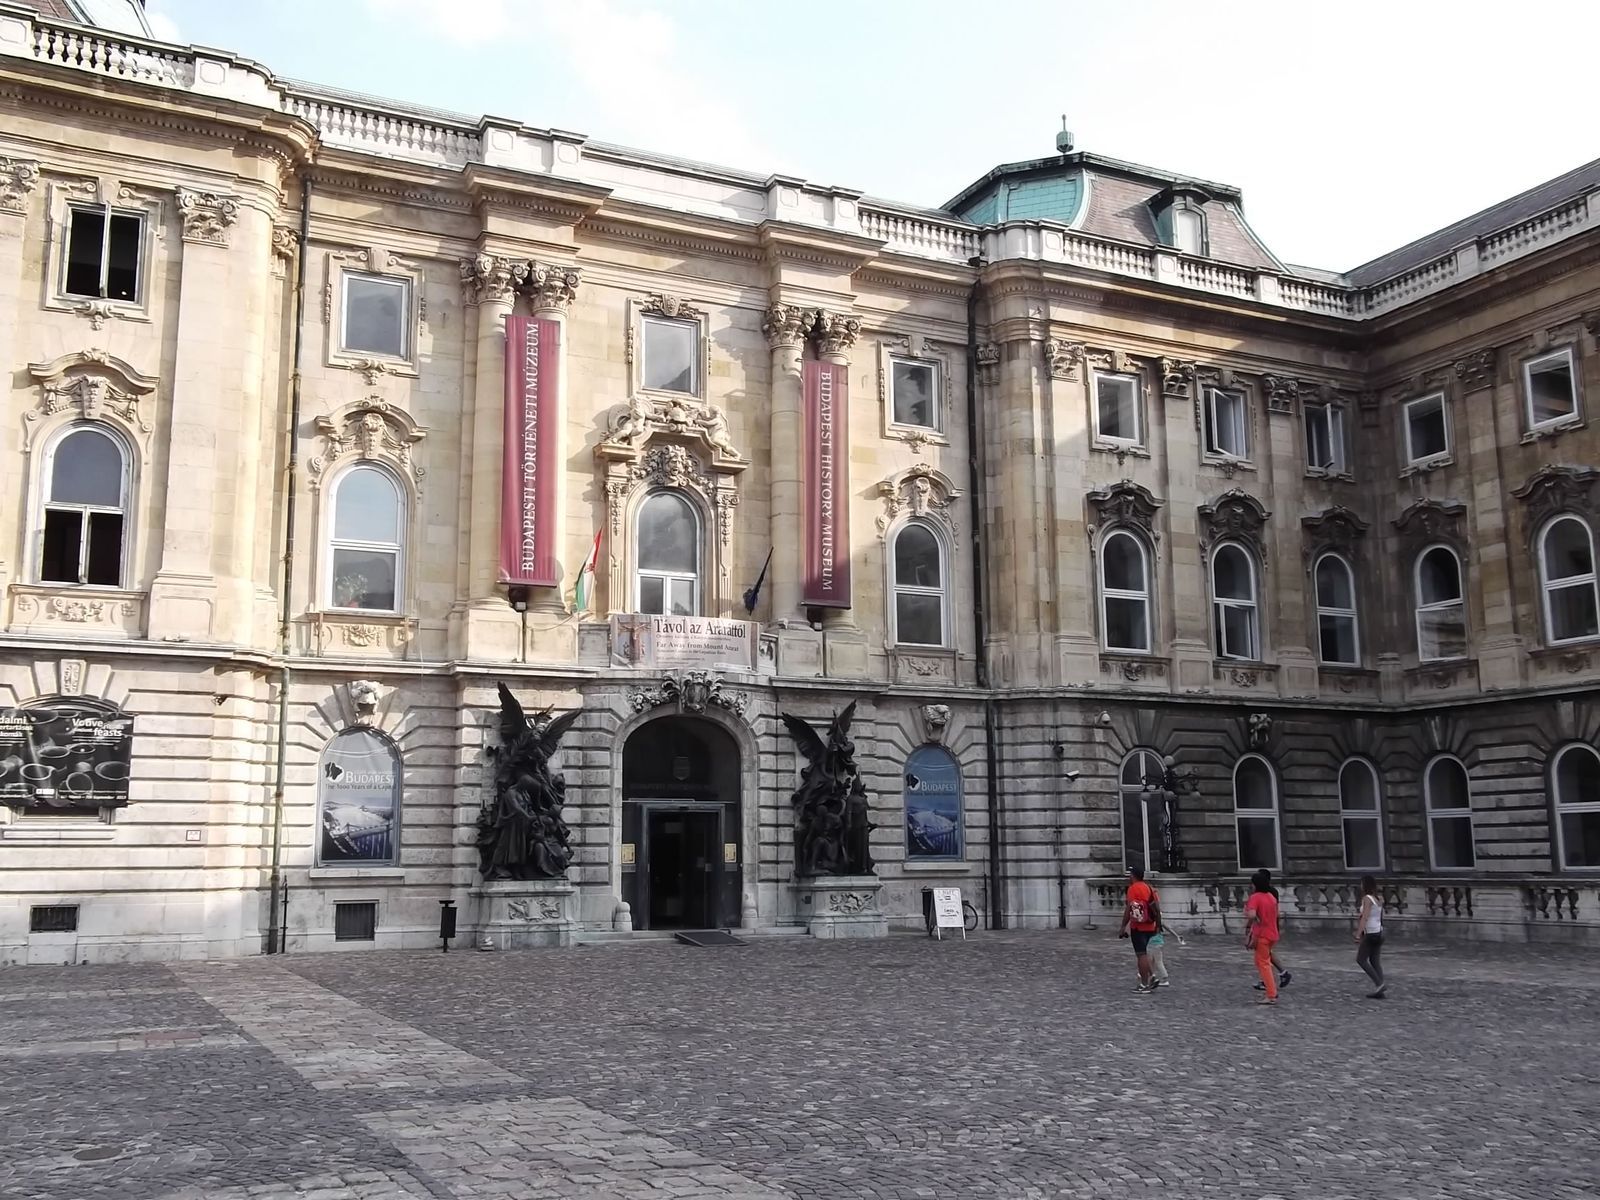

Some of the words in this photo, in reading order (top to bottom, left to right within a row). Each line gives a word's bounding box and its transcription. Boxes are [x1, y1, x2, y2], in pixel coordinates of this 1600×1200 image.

[522, 322, 539, 390] MÚZEUM
[520, 394, 537, 482] TÖRTÉNETI
[820, 372, 832, 449] BUDAPEST
[821, 455, 832, 519] HISTORY
[521, 487, 536, 572] BUDAPESTI
[821, 522, 833, 590] MUSEUM
[654, 618, 686, 634] Távol
[689, 623, 702, 634] az
[706, 621, 746, 639] Araráttól
[71, 718, 104, 727] Votive
[93, 728, 123, 737] feasts
